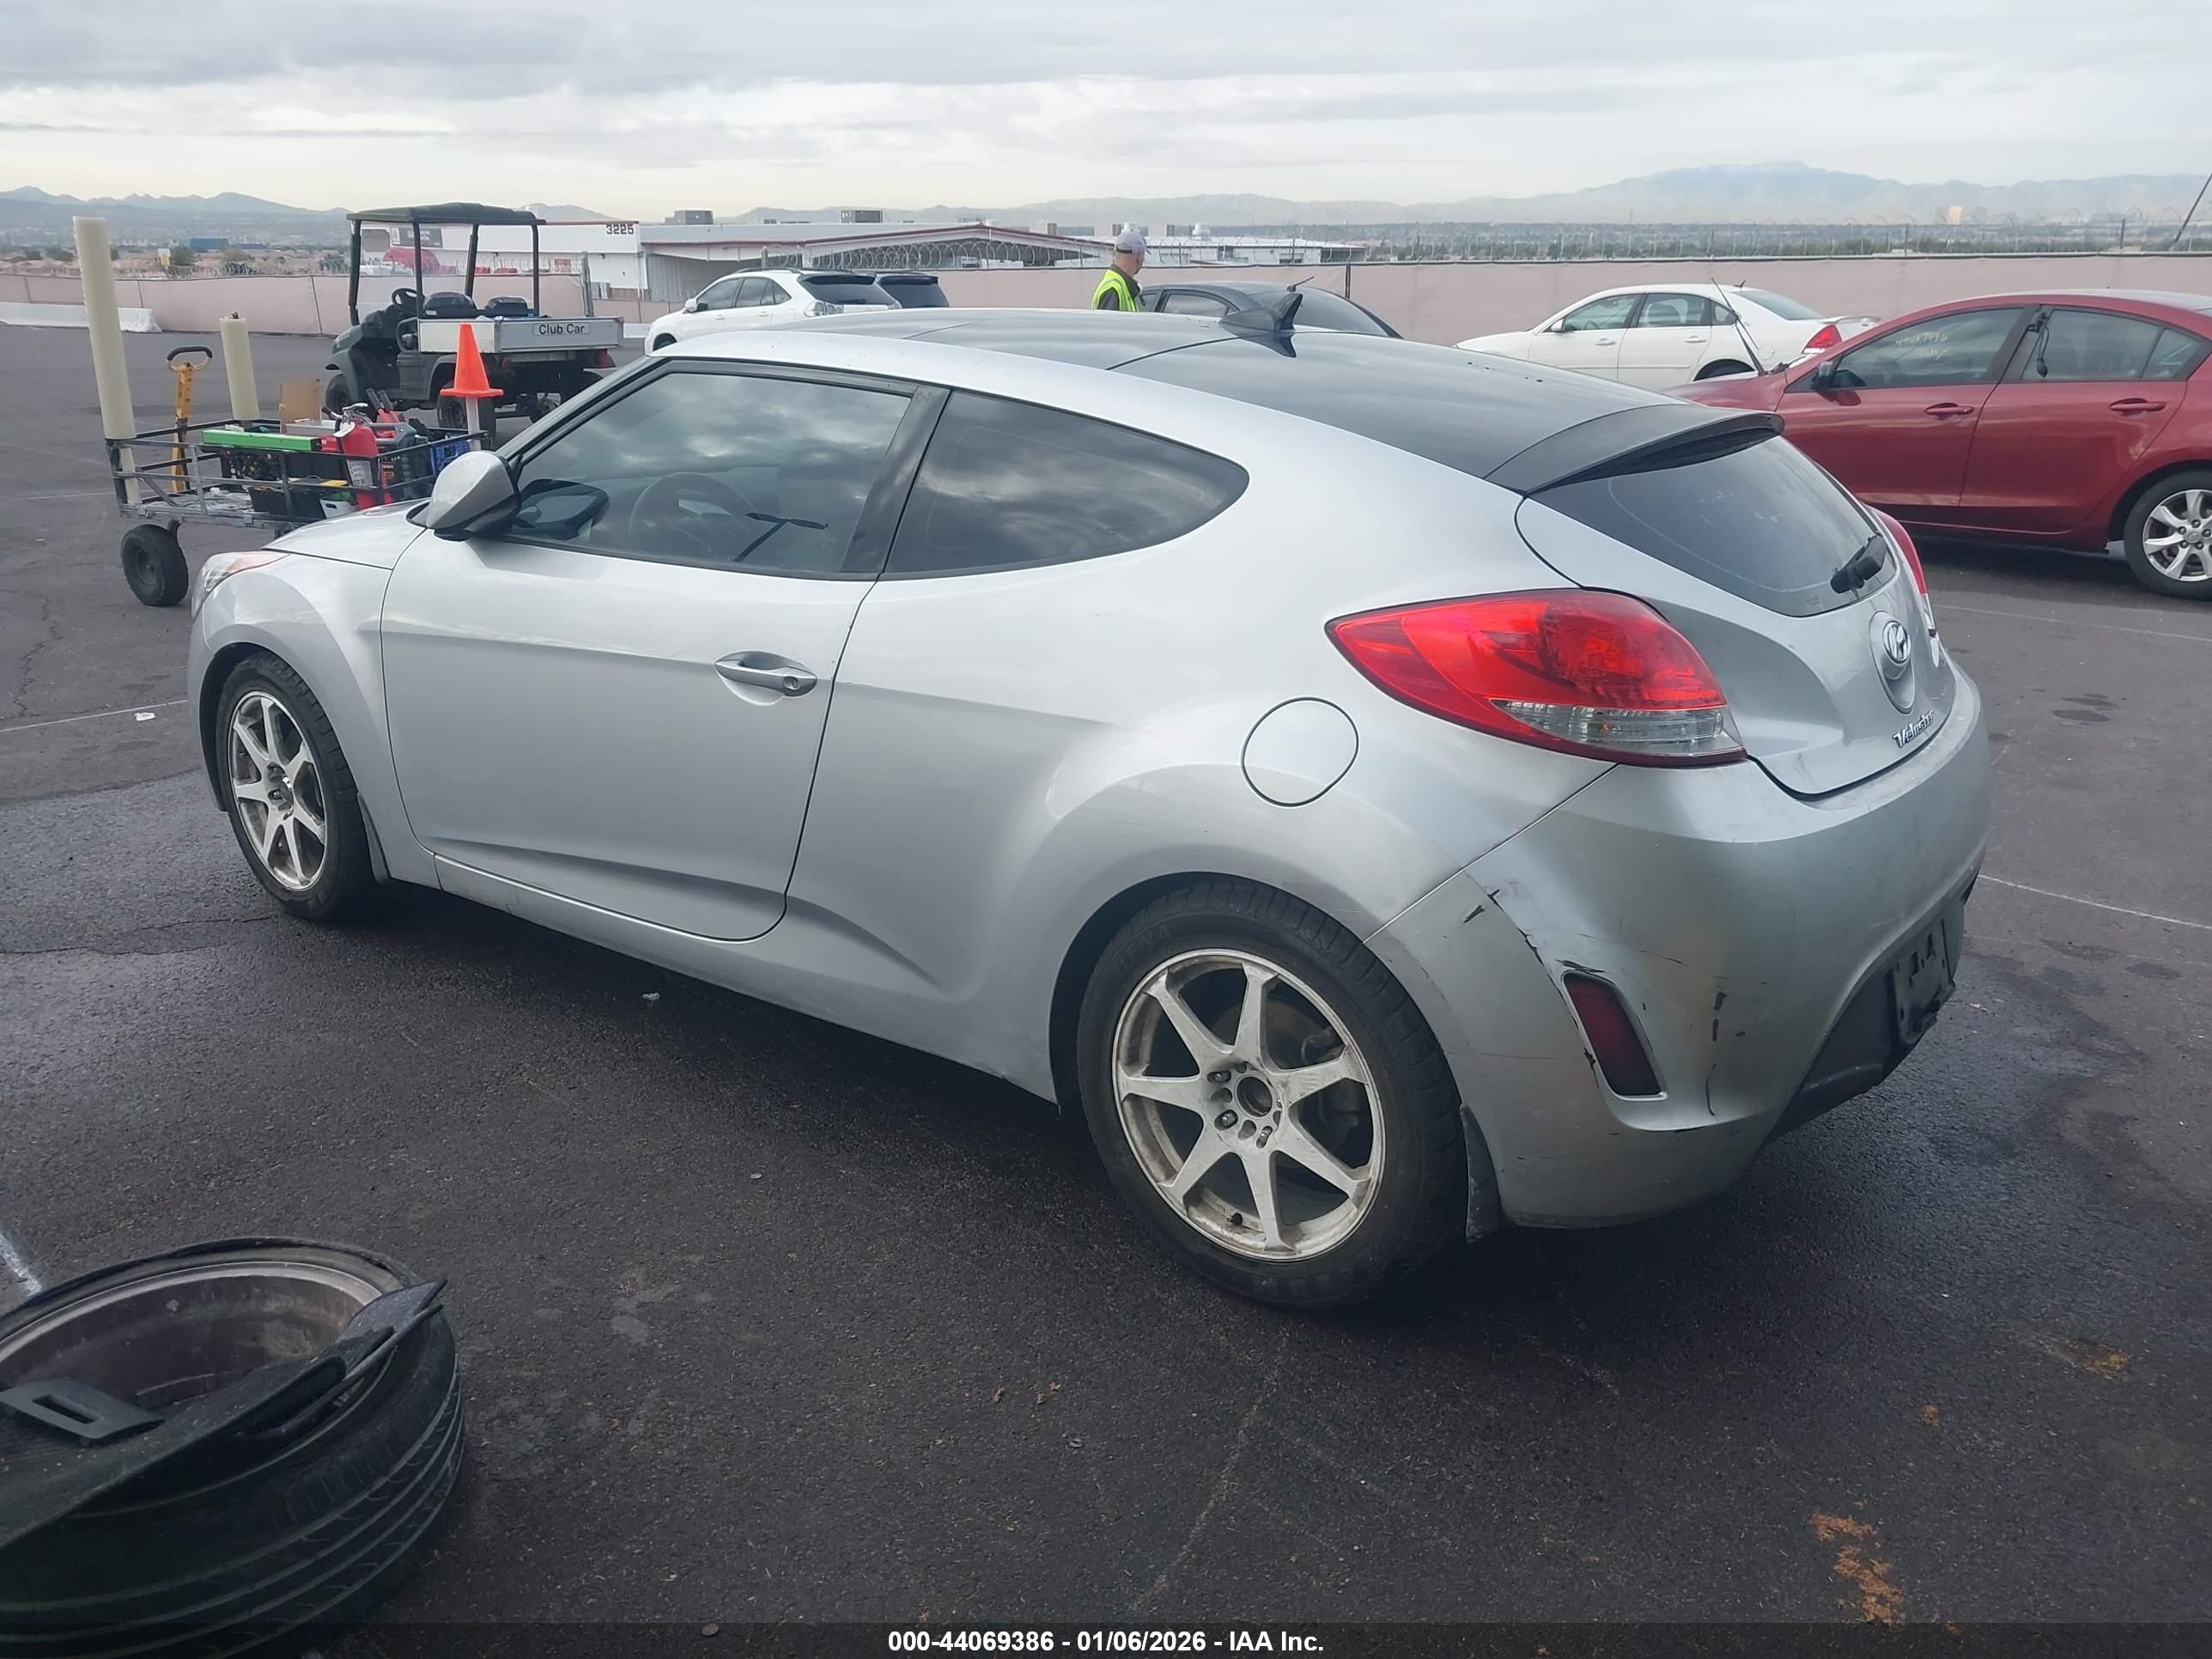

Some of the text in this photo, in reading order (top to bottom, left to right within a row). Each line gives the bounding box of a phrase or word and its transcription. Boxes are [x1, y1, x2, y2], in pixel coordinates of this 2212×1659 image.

[606, 223, 634, 234] 3225
[538, 323, 585, 335] Club Car
